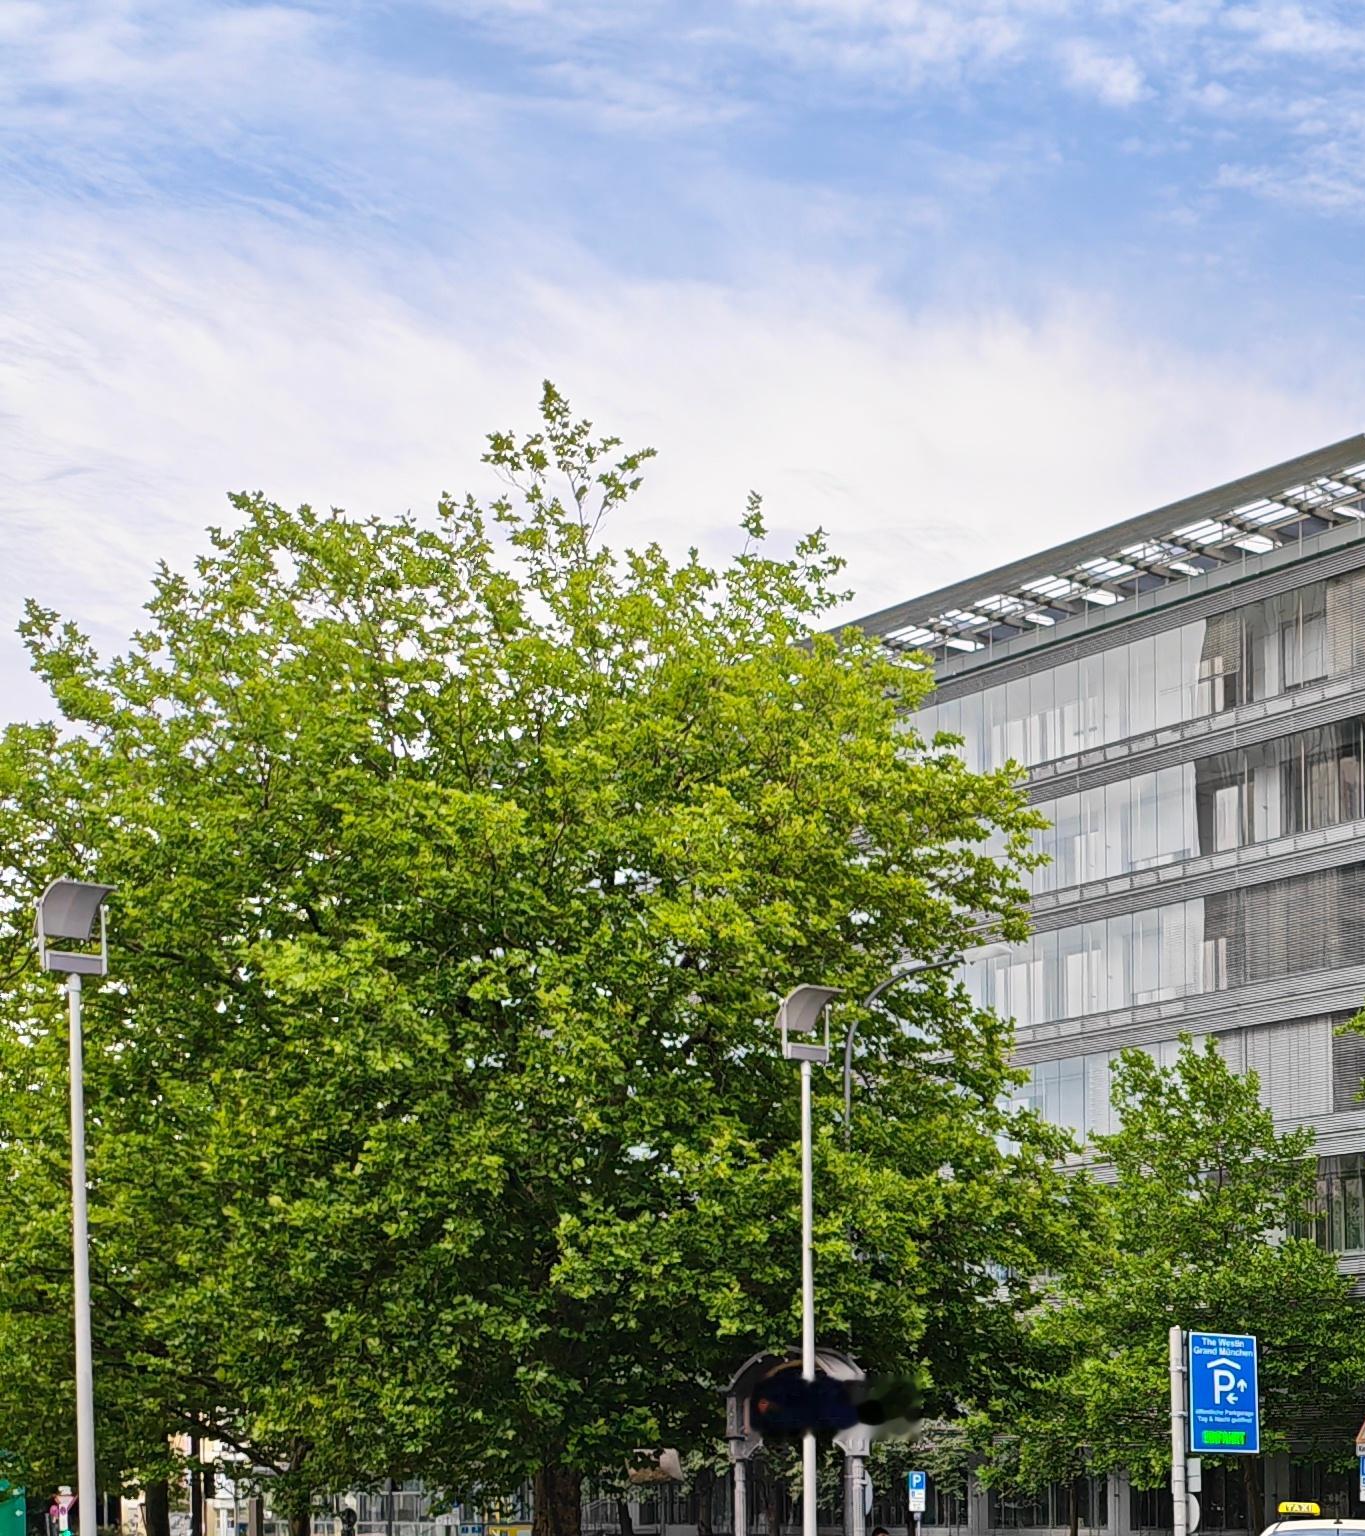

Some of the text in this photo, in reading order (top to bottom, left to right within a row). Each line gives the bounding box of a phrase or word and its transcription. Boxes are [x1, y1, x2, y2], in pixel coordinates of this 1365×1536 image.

[1202, 1337, 1217, 1346] The
[1193, 1346, 1218, 1355] Grand
[1213, 1368, 1236, 1405] P
[912, 1474, 921, 1487] P
[1286, 1503, 1313, 1512] TAXI
